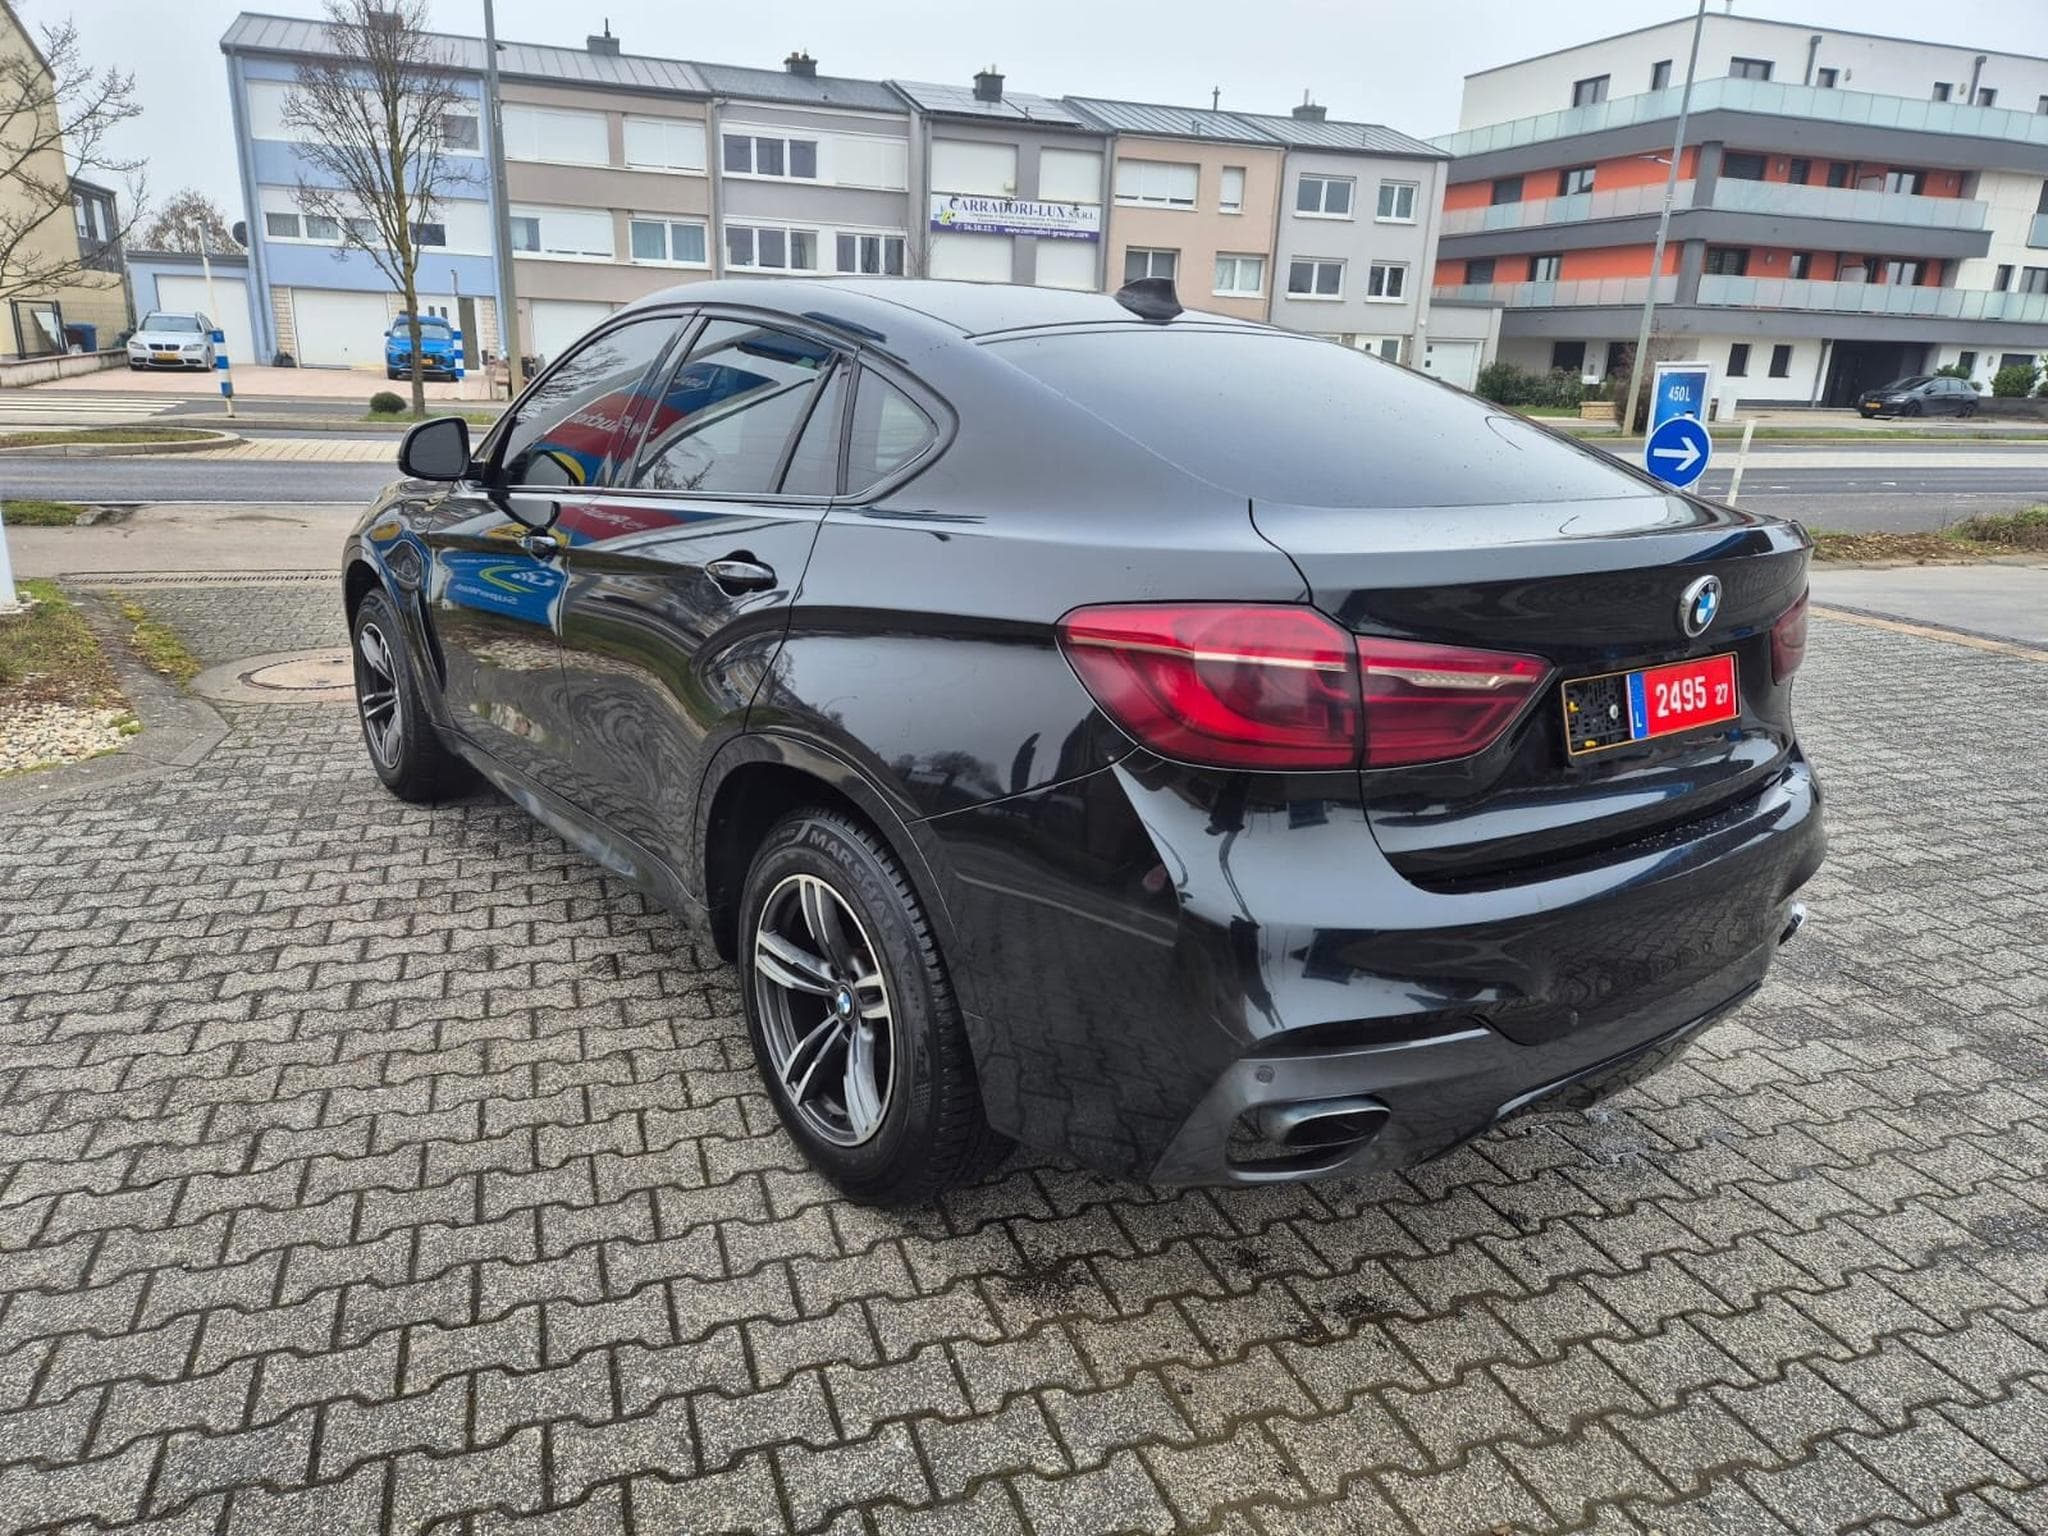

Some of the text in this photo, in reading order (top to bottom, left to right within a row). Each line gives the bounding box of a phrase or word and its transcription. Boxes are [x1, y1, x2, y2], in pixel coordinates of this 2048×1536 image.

[950, 198, 1065, 218] CARRADORI-LUX
[1635, 676, 1729, 728] L 2495 27
